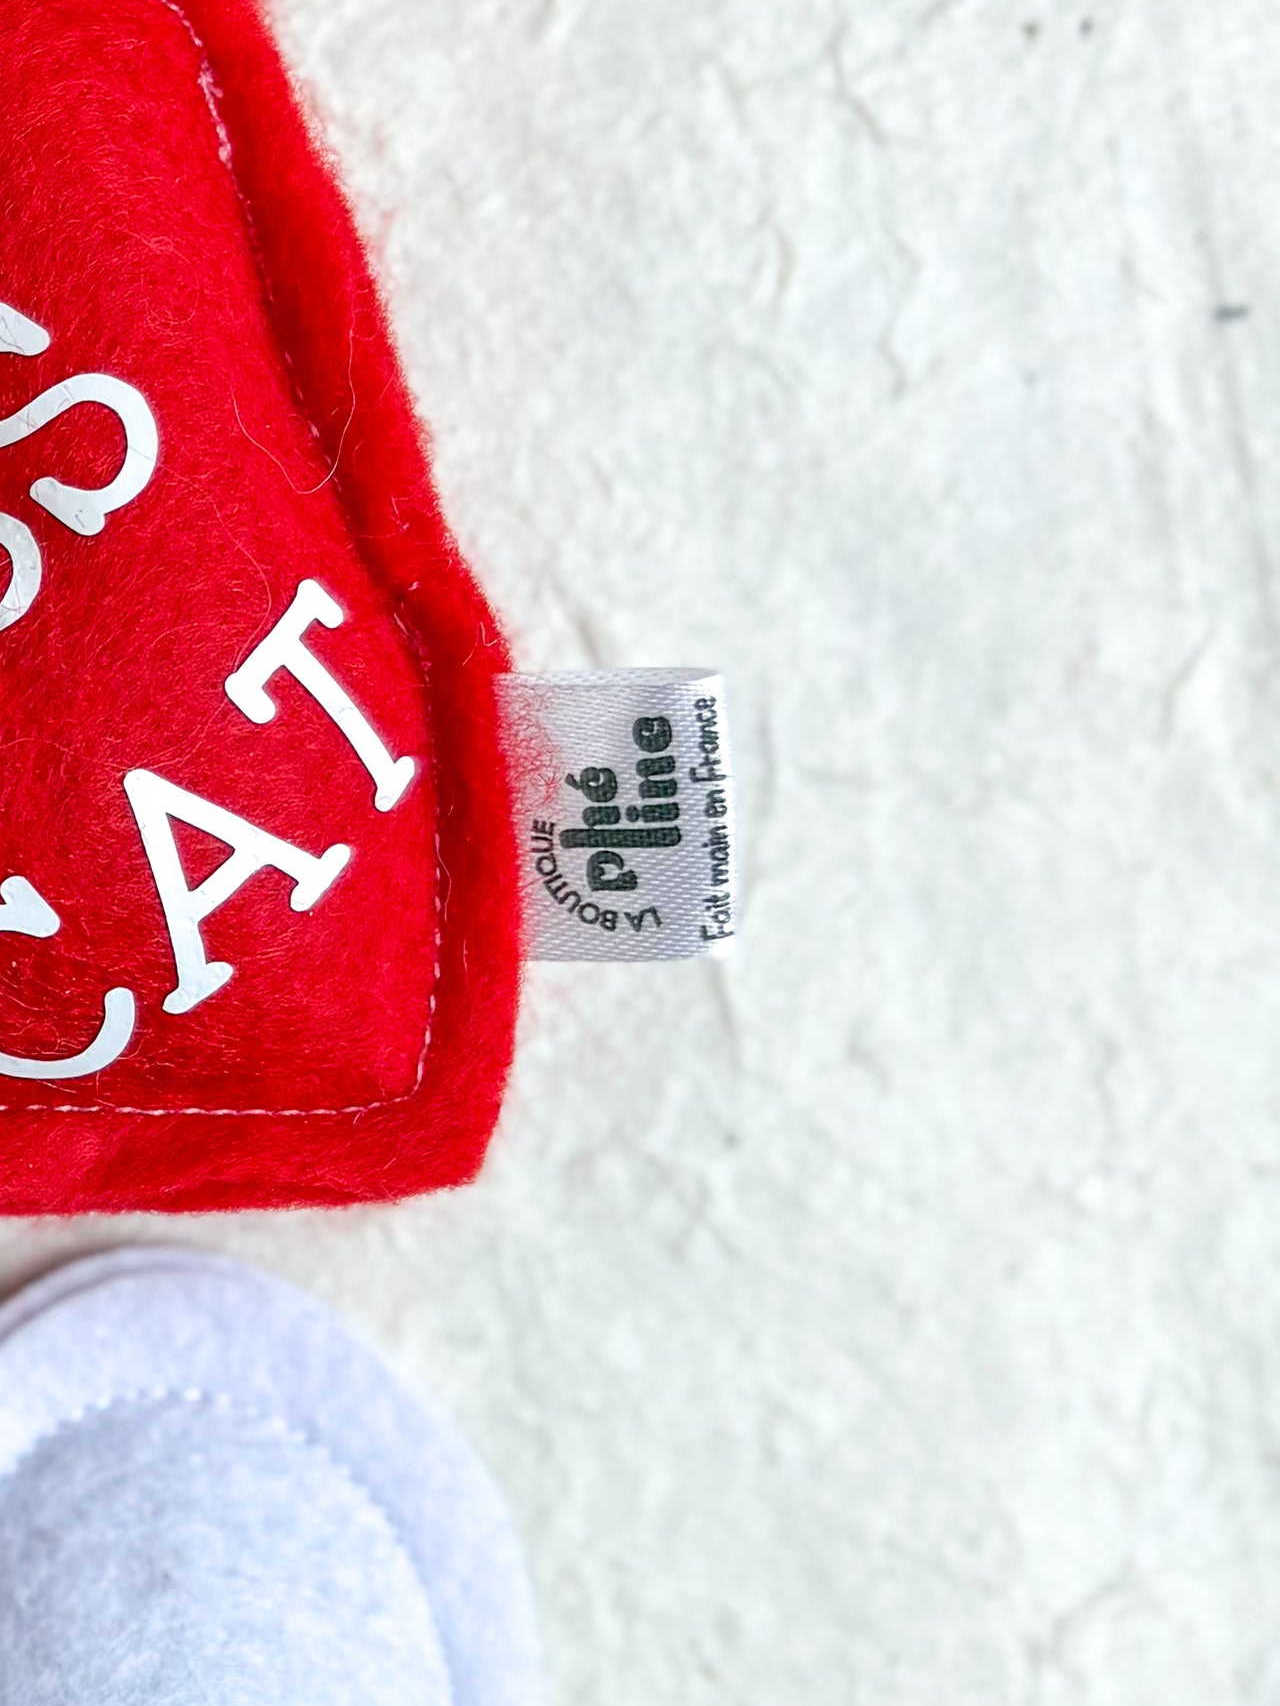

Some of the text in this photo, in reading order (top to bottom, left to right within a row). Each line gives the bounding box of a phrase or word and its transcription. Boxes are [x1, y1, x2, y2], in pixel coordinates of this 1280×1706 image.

[531, 819, 662, 933] LA BOUTIQUE
[690, 695, 735, 941] Fait main en France
